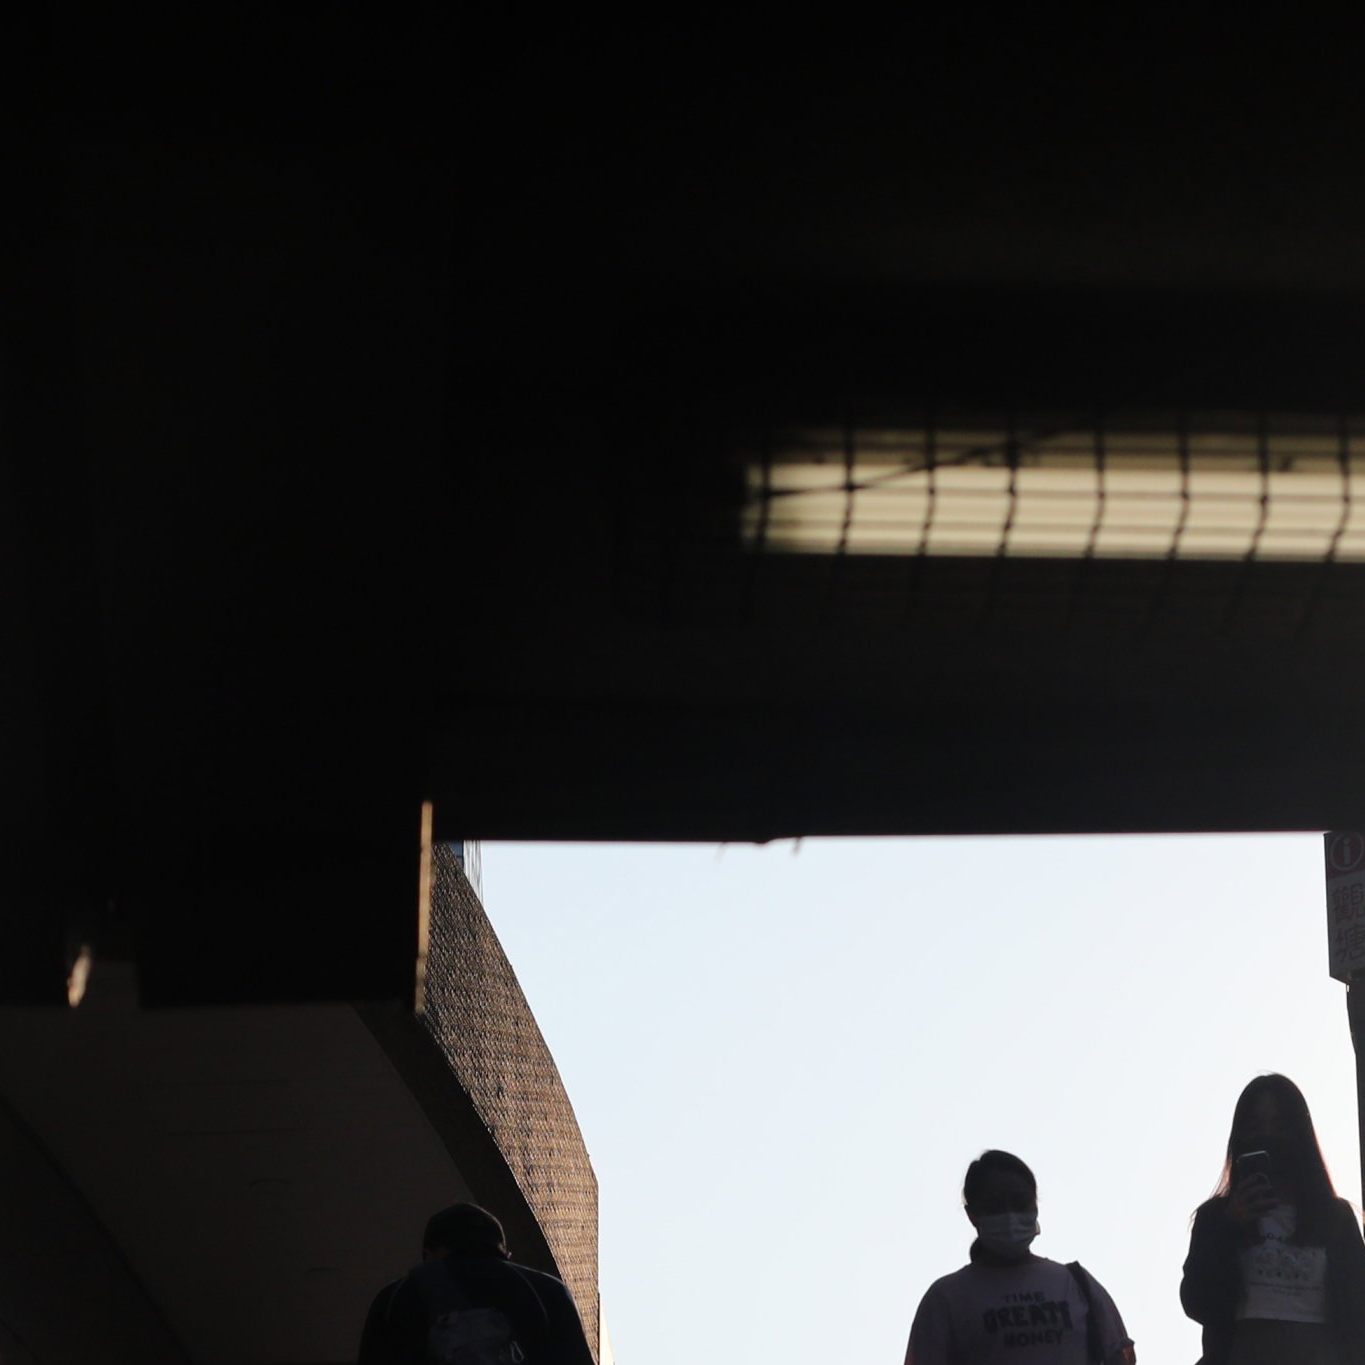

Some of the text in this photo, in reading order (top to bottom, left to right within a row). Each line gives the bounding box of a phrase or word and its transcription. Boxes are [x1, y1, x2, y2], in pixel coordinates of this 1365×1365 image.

[1332, 882, 1365, 963] 觀塘
[1001, 1291, 1045, 1303] TIME
[1003, 1330, 1063, 1348] MONEY
